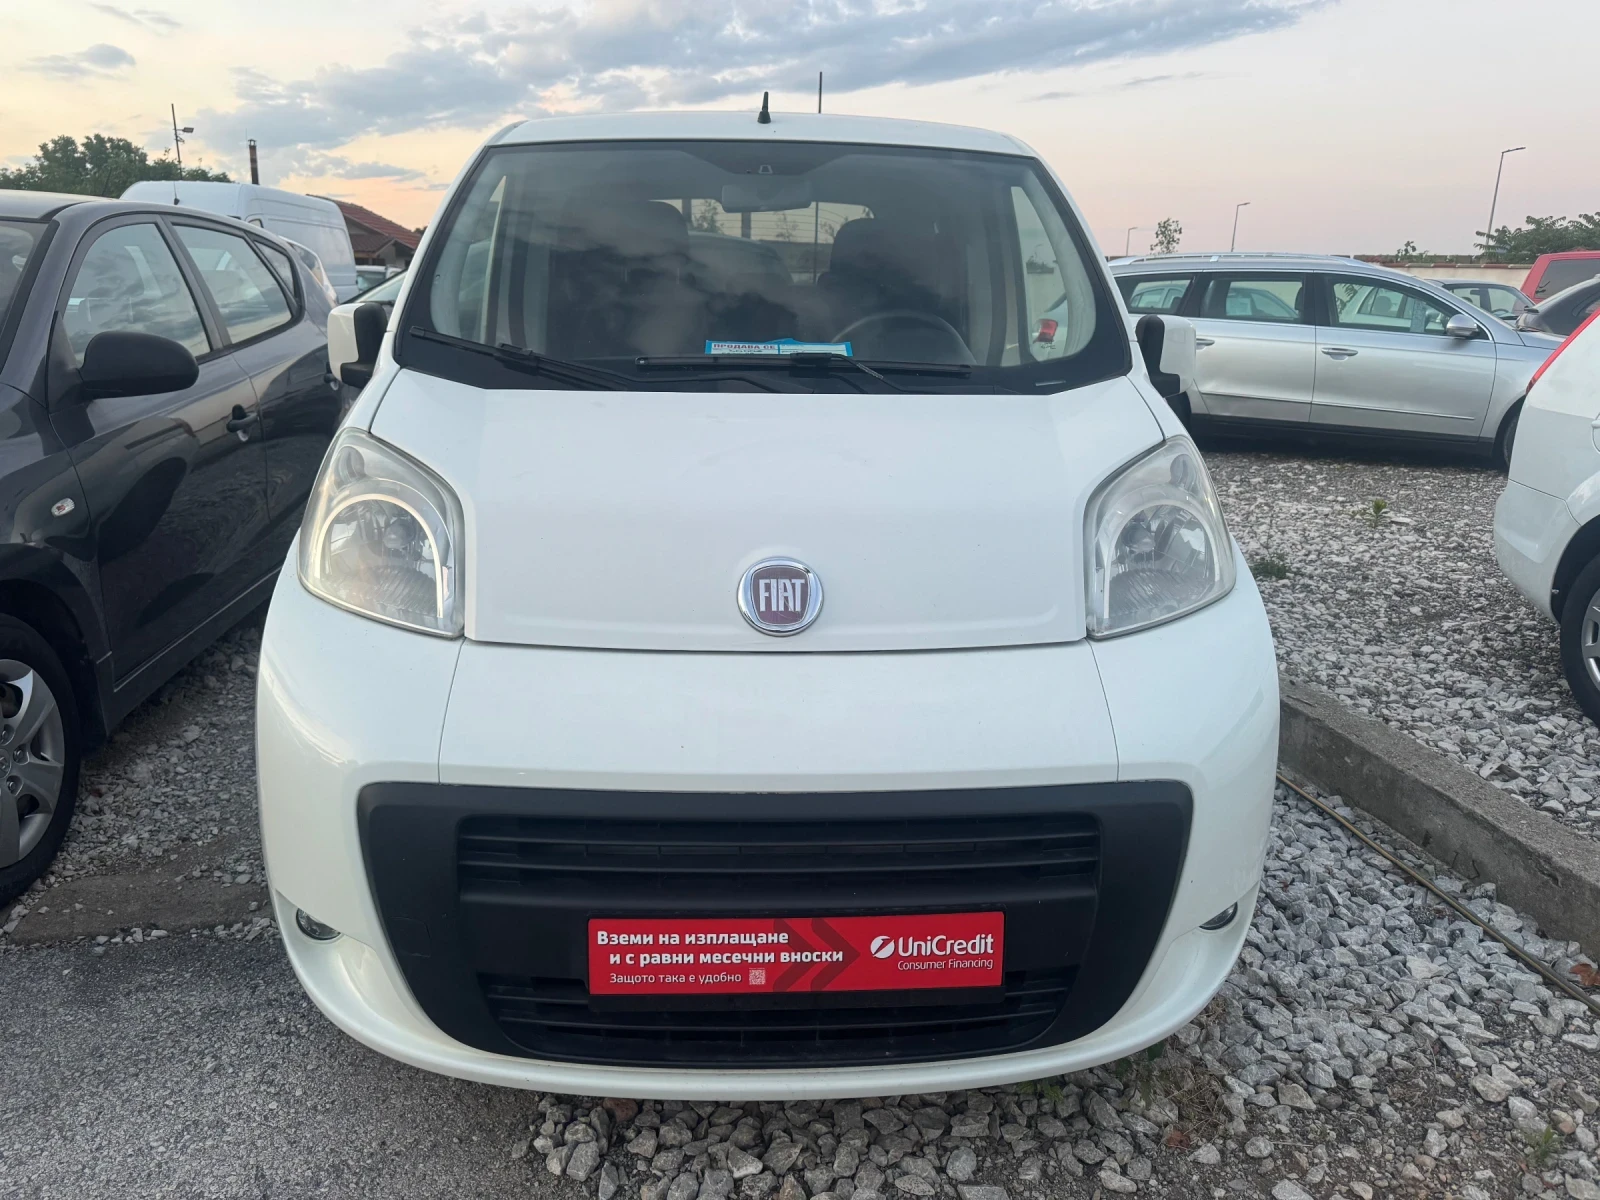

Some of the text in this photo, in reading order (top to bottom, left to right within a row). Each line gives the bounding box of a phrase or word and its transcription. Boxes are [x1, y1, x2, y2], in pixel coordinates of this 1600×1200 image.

[759, 578, 805, 612] FIAT
[597, 930, 789, 947] Вземи на изплащане
[897, 933, 994, 957] UniCredit
[609, 950, 843, 967] и с равни месечни вноски
[897, 957, 993, 971] Consumer Financing
[609, 971, 742, 985] Защото така е удобно
